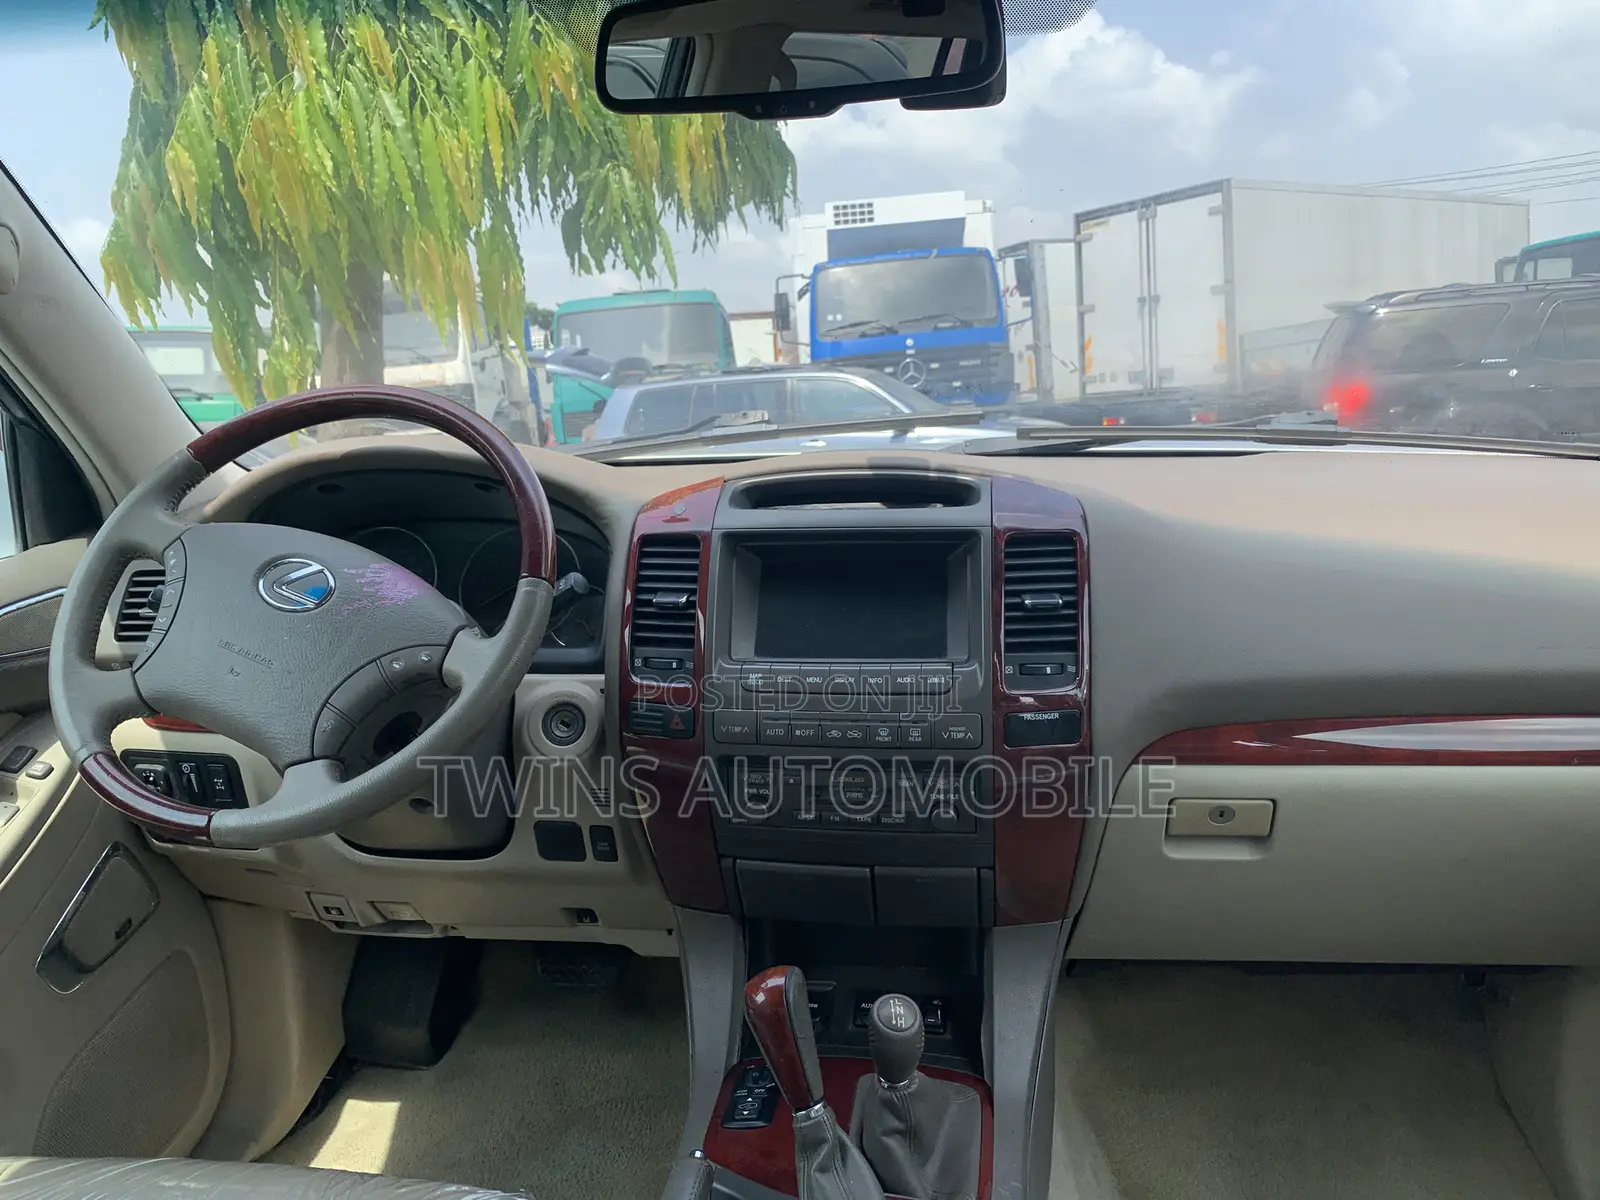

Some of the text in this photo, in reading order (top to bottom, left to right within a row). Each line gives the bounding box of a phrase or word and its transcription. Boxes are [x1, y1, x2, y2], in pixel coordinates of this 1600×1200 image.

[766, 728, 784, 736] AUTO
[950, 731, 965, 739] TEMP
[897, 1016, 905, 1028] H
